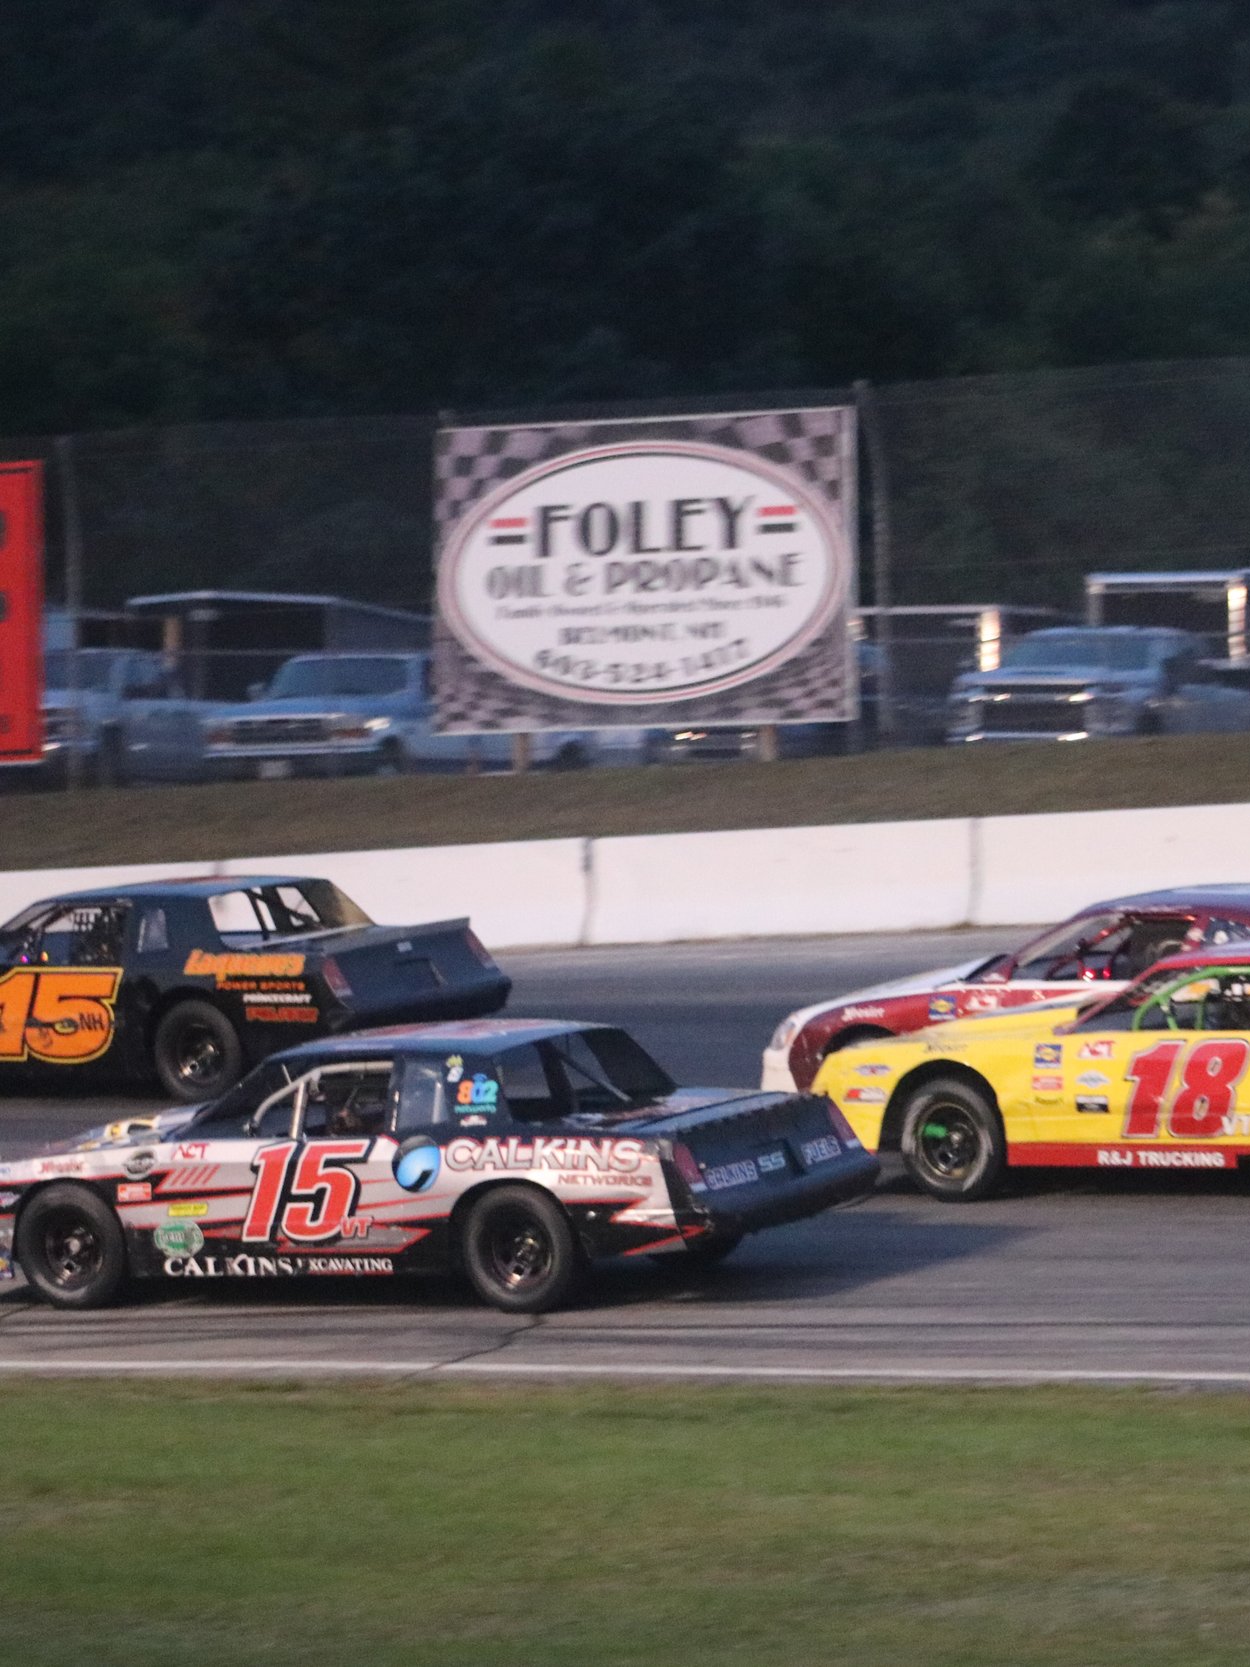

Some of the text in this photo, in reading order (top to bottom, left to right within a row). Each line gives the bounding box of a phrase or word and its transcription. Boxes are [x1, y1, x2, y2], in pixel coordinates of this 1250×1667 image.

[533, 494, 758, 558] FOLEY
[486, 553, 805, 599] OIL & PROPANE
[0, 966, 123, 1064] 15
[78, 1013, 106, 1032] NH
[456, 1079, 499, 1105] 802
[1122, 1038, 1250, 1139] 18
[446, 1136, 645, 1173] CALKINS
[1097, 1150, 1226, 1168] R&J TRUCKING
[242, 1138, 371, 1246] 15
[557, 1173, 653, 1188] NETWORKS
[340, 1215, 375, 1239] VT
[163, 1253, 296, 1278] CALKINS
